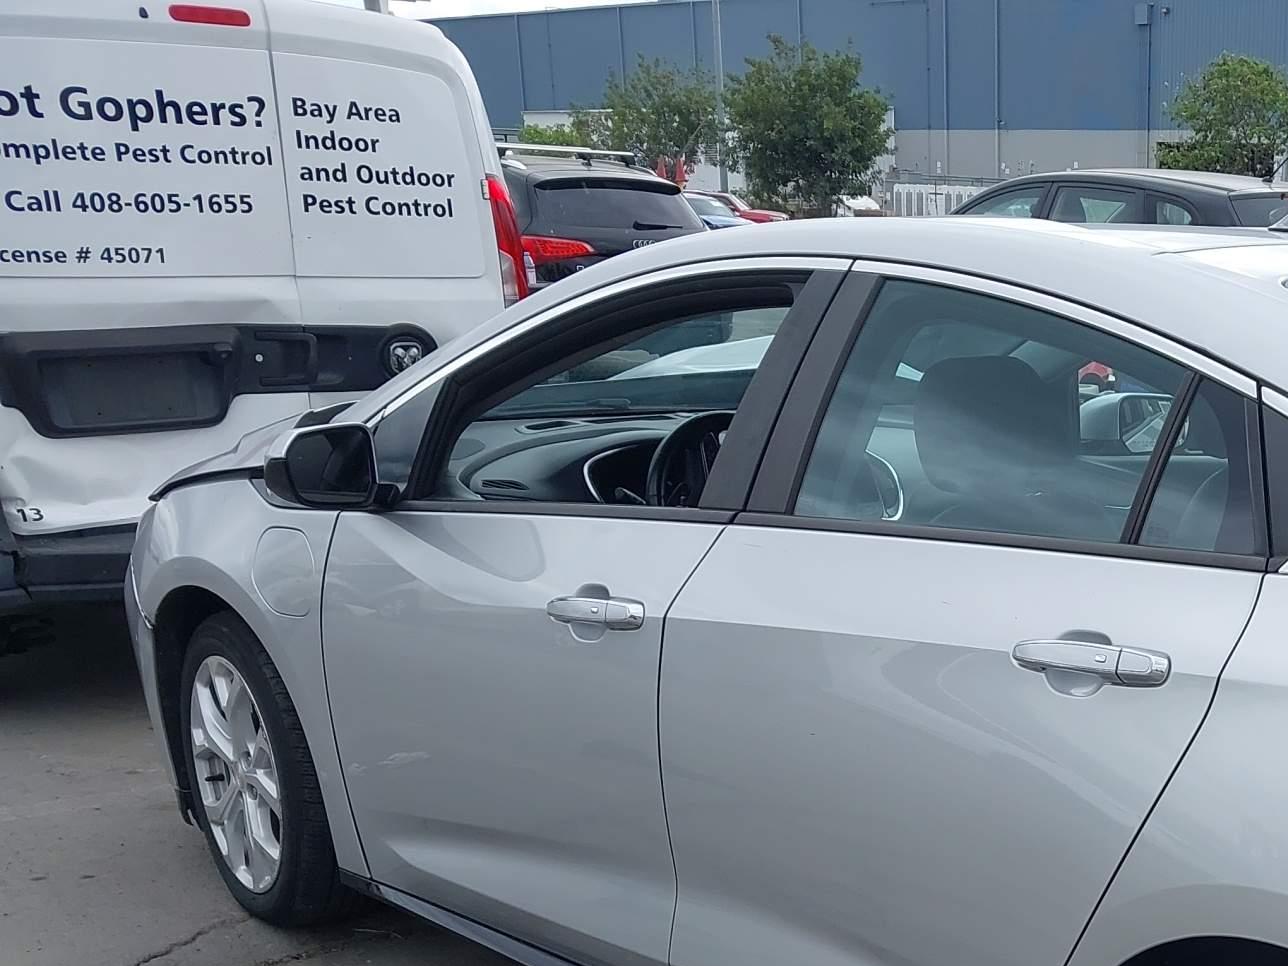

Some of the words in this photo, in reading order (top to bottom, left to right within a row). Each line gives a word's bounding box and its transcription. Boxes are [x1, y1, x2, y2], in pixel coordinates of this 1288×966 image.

[59, 86, 266, 132] Gophers?
[291, 96, 338, 124] Bay
[346, 100, 401, 124] Area
[0, 138, 106, 165] mplete
[114, 142, 172, 163] Pest
[179, 144, 273, 166] Control
[295, 129, 380, 153] Indoor
[299, 162, 348, 183] and
[356, 164, 455, 187] Outdoor
[4, 190, 62, 212] Call
[72, 191, 254, 214] 408-605-1655
[302, 193, 358, 215] Pest
[364, 196, 454, 218] Control
[75, 246, 92, 264] #
[99, 247, 166, 264] 45071
[16, 508, 44, 522] 13
